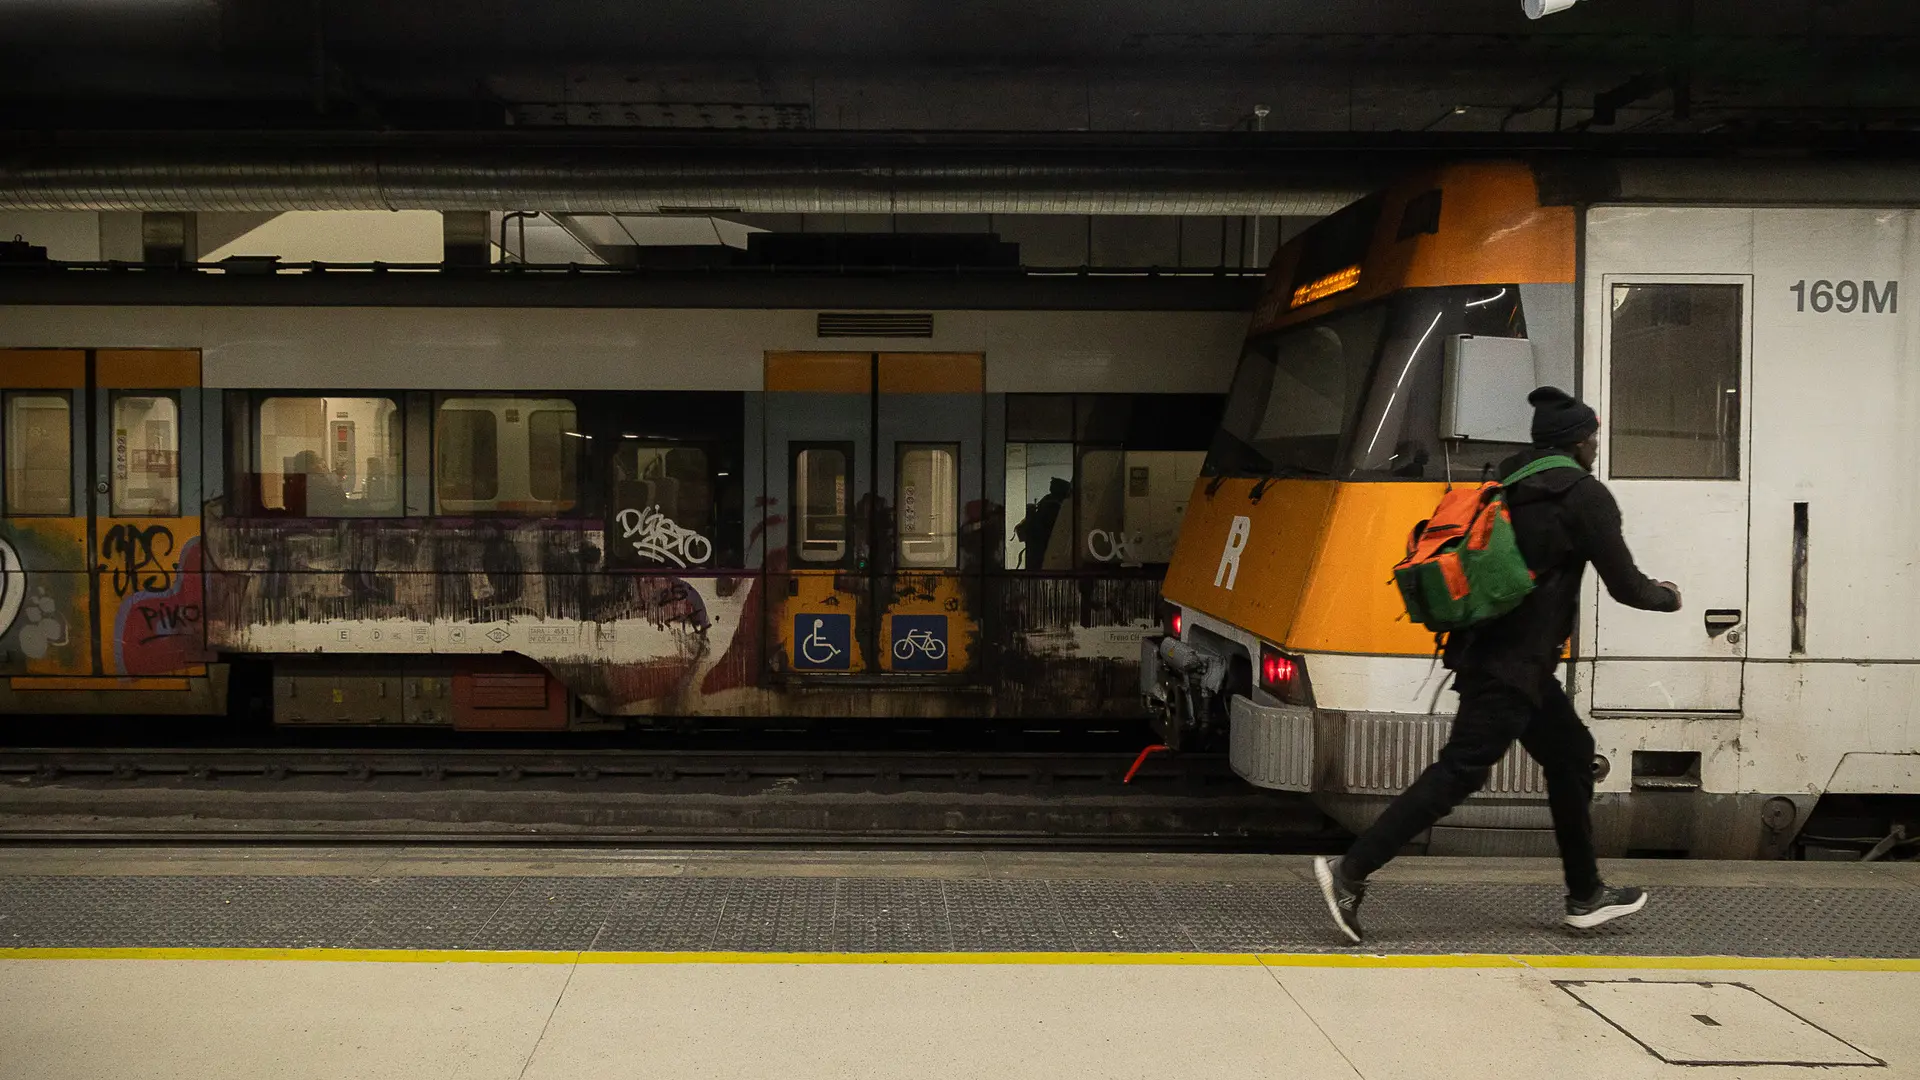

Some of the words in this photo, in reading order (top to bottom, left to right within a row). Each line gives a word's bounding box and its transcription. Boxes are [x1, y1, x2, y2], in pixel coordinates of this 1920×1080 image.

[1789, 279, 1898, 314] 169M
[1214, 515, 1251, 591] R
[340, 630, 348, 640] E
[374, 630, 381, 640] D
